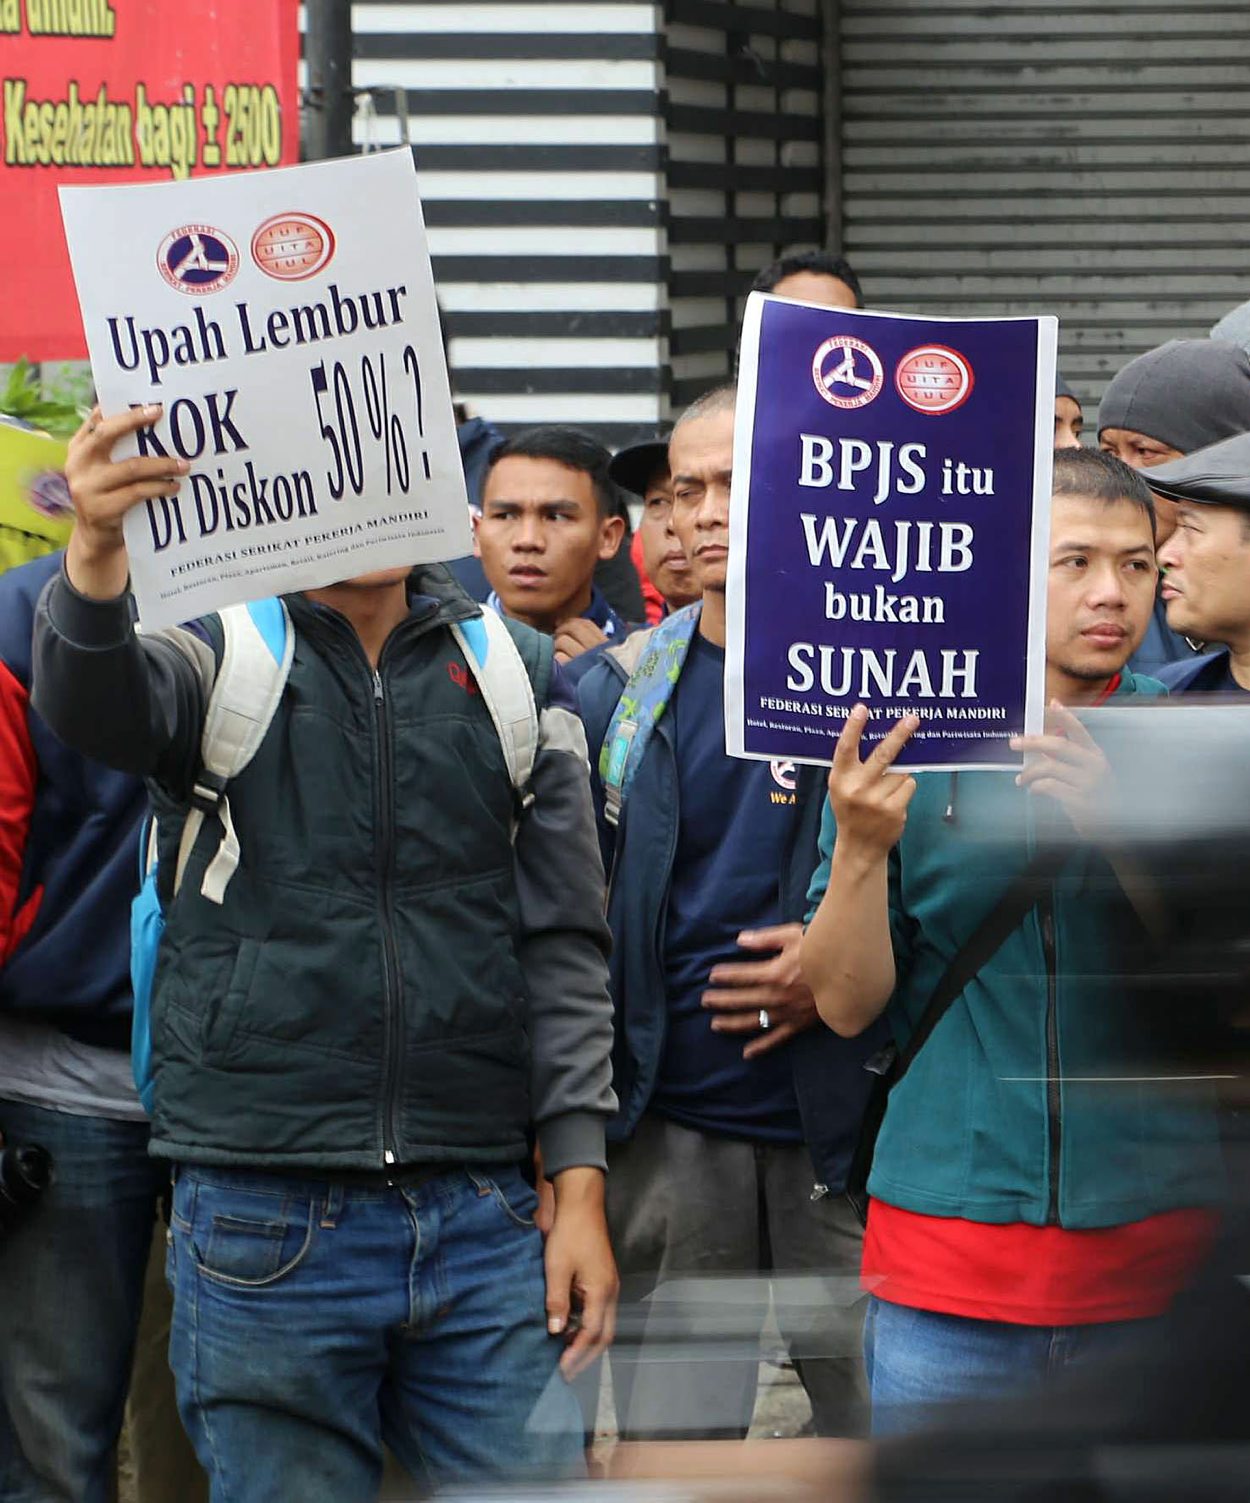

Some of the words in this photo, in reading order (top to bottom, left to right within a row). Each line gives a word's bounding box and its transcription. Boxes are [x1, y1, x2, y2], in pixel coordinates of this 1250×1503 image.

[3, 79, 135, 165] Kesehatan
[136, 82, 196, 181] bagi
[223, 83, 281, 168] 2500
[107, 306, 229, 385] Upah
[237, 284, 407, 355] Lembur
[907, 375, 954, 384] UITA
[190, 461, 318, 538] Diskon
[798, 433, 926, 504] BPJS
[942, 458, 995, 495] itu
[170, 551, 237, 578] FEDERASI
[240, 540, 300, 557] SERIKAT
[305, 523, 364, 546] PEKERJA
[367, 510, 429, 530] MANDIRI
[800, 512, 975, 582] WAJIB
[824, 582, 946, 623] bukan
[786, 642, 980, 698] SUNAH
[760, 697, 822, 716] FEDERASI
[826, 704, 882, 720] SERAT
[946, 707, 1006, 719] MANDIRI
[770, 791, 787, 804] We
